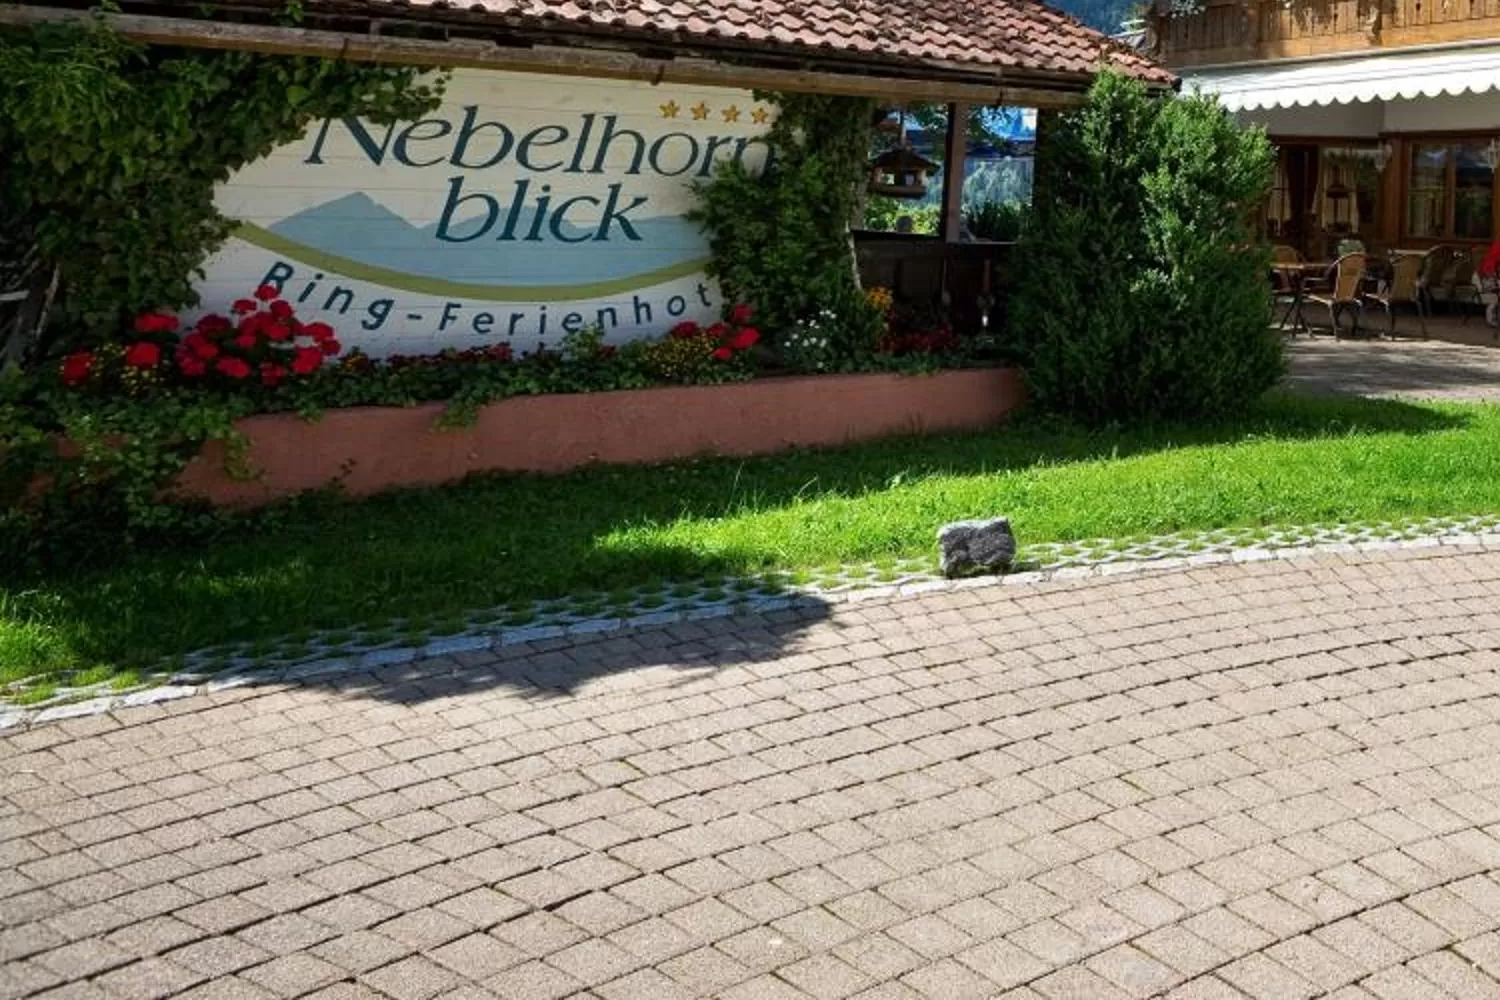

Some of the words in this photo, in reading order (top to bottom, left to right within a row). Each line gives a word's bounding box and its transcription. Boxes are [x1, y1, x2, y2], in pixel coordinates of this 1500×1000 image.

[304, 104, 778, 182] Nebelhorn
[435, 175, 648, 243] blick
[258, 261, 712, 336] Ring-Ferienhot
